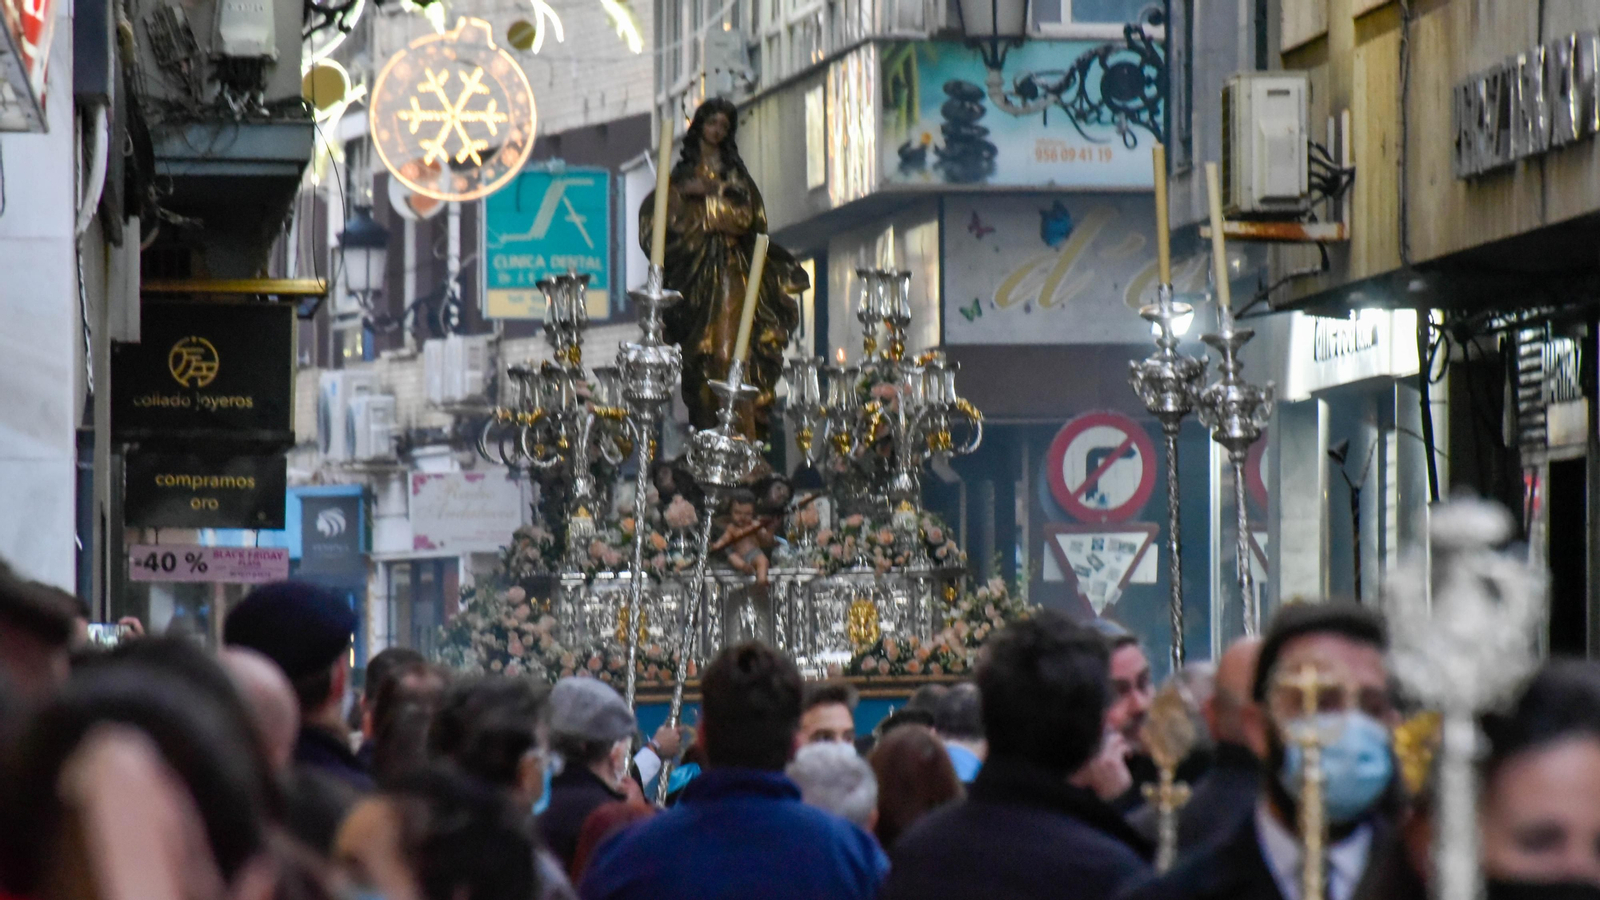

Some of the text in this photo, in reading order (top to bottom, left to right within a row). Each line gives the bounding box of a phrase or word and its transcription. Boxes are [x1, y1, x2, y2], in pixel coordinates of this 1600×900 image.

[551, 255, 602, 270] DENTAL
[133, 391, 254, 412] collado joyeros
[155, 474, 256, 491] compramos
[190, 498, 219, 510] oro
[134, 552, 208, 573] -40 %
[213, 550, 283, 560] BLACK FRIDAY
